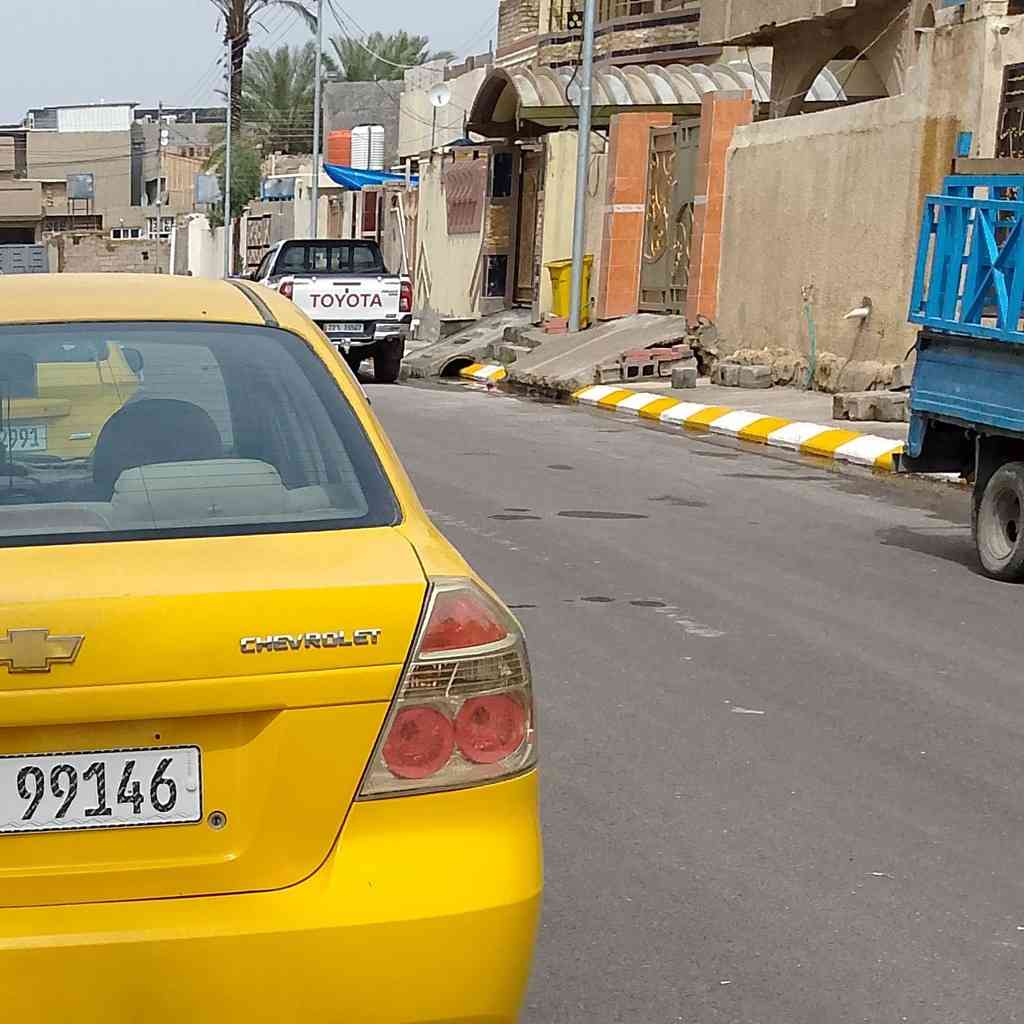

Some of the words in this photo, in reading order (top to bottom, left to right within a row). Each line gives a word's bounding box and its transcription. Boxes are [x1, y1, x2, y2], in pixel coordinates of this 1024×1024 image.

[310, 294, 382, 308] TOYOTA
[240, 628, 381, 654] CHEVROLET
[16, 758, 177, 821] 99146
